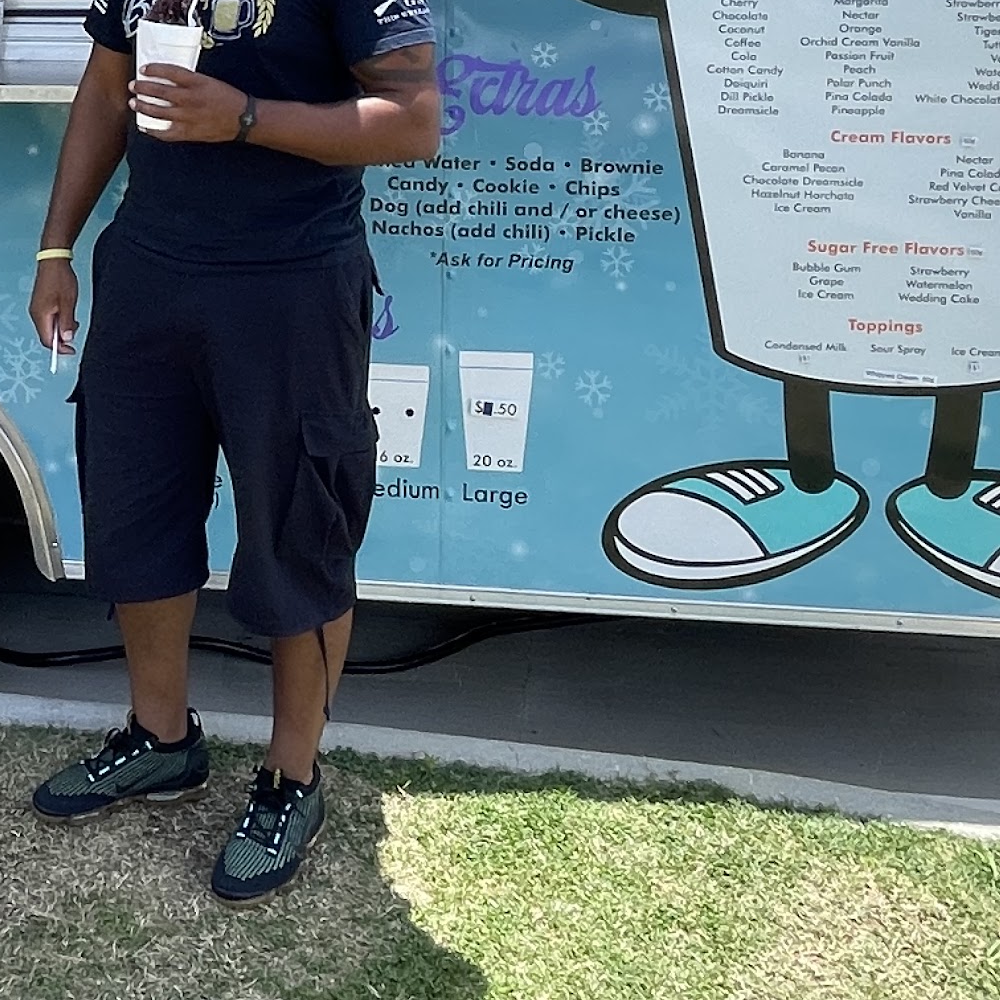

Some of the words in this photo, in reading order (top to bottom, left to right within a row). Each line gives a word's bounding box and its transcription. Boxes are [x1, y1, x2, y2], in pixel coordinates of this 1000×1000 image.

[712, 10, 768, 20] Chocolate
[719, 24, 765, 34] Coconut
[839, 23, 882, 35] Orange
[725, 38, 761, 47] Coffee
[841, 37, 879, 47] Cream
[732, 51, 757, 61] Cola
[825, 51, 866, 60] Passion
[870, 51, 895, 61] Fruit
[707, 64, 744, 74] Cotton
[748, 65, 784, 77] Candy
[843, 64, 876, 74] Peach
[827, 78, 854, 88] Polar
[858, 78, 892, 88] Punch
[721, 92, 739, 101] Dill
[743, 92, 774, 101] Pickle
[852, 92, 893, 101] Colada
[831, 130, 885, 143] Cream
[891, 131, 951, 144] Flavors
[506, 156, 555, 173] Soda
[580, 158, 664, 175] Brownie
[388, 176, 449, 196] Candy
[473, 178, 540, 194] Cookie
[565, 180, 620, 199] Chips
[370, 198, 409, 217] Dog
[416, 200, 461, 217] (add
[468, 200, 507, 217] chili
[514, 202, 553, 218] and
[575, 206, 598, 219] or
[603, 204, 681, 225] cheese)
[372, 220, 444, 237] Nachos
[451, 223, 496, 241] (add
[502, 223, 551, 243] chili)
[576, 226, 636, 243] Pickle
[808, 240, 856, 256] Sugar
[863, 241, 899, 255] Free
[904, 242, 965, 256] Flavors
[477, 252, 503, 268] for
[507, 253, 575, 274] Pricing
[848, 318, 923, 336] Toppings
[475, 400, 517, 417] $.50
[394, 454, 414, 463] oz.
[473, 455, 491, 467] 20
[497, 458, 517, 468] oz.
[373, 478, 440, 499] edium
[462, 483, 528, 509] Large
